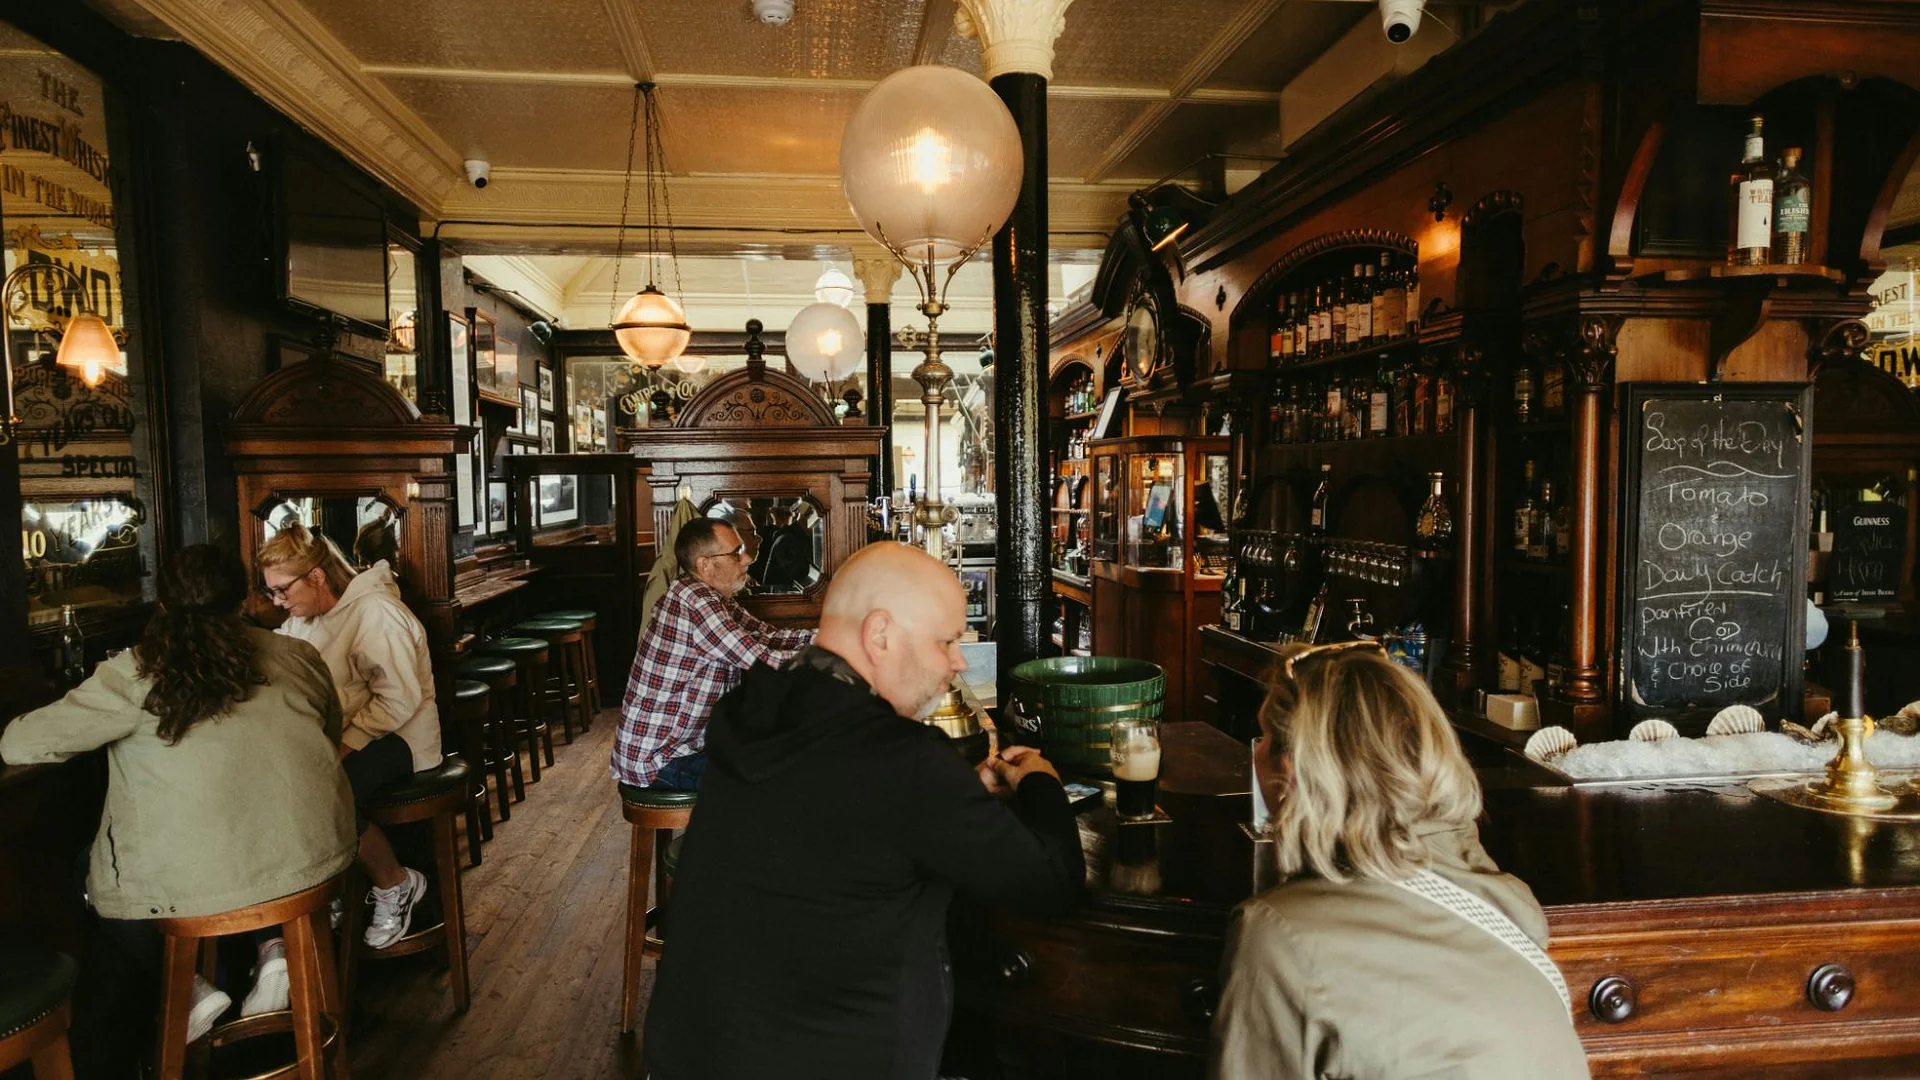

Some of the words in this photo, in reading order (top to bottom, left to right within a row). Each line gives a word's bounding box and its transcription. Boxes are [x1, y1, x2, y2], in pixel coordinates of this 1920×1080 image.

[38, 70, 84, 117] THE
[1, 163, 26, 198] IN
[31, 174, 68, 213] THE
[1691, 424, 1710, 457] of
[1712, 418, 1738, 450] the
[1739, 420, 1783, 469] Day
[61, 453, 142, 478] SPECIAL
[1648, 477, 1768, 507] Tomato
[1658, 522, 1752, 557] Orange
[1717, 559, 1782, 590] Catch
[1668, 660, 1723, 680] Choice
[1730, 658, 1752, 674] of
[1703, 673, 1751, 693] Side
